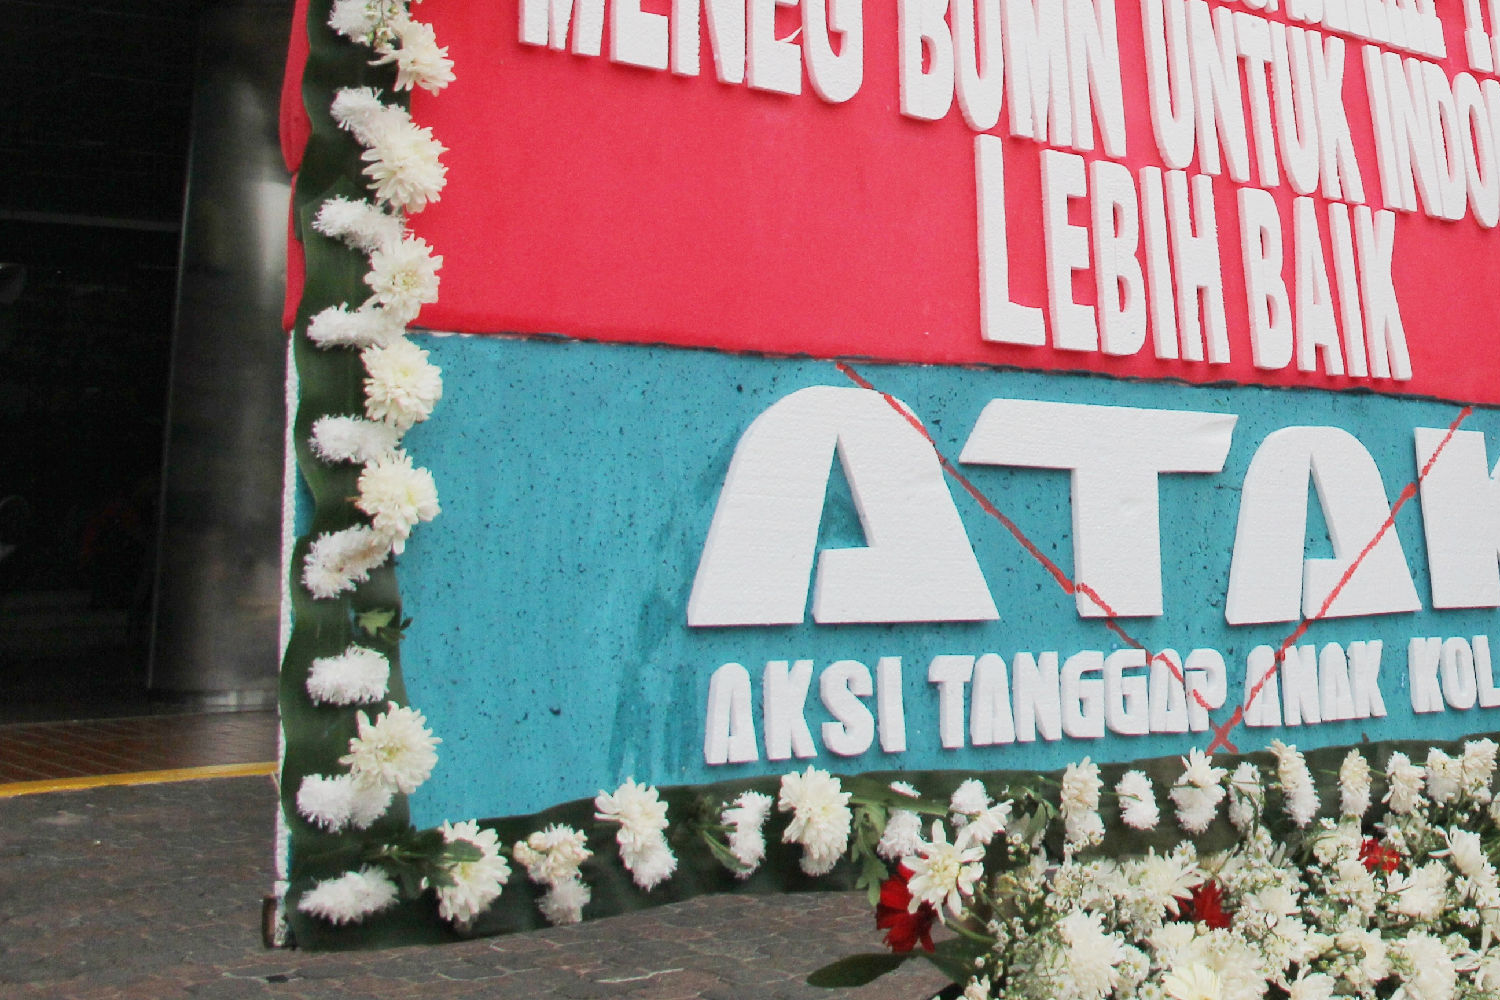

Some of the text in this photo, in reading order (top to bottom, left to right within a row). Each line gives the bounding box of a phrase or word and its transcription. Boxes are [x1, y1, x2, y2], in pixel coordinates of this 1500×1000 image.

[974, 133, 1413, 381] LEBIH BAIK
[704, 654, 907, 767] AKSI
[928, 648, 1229, 751] TANGGAP
[1243, 639, 1387, 728] ANAK
